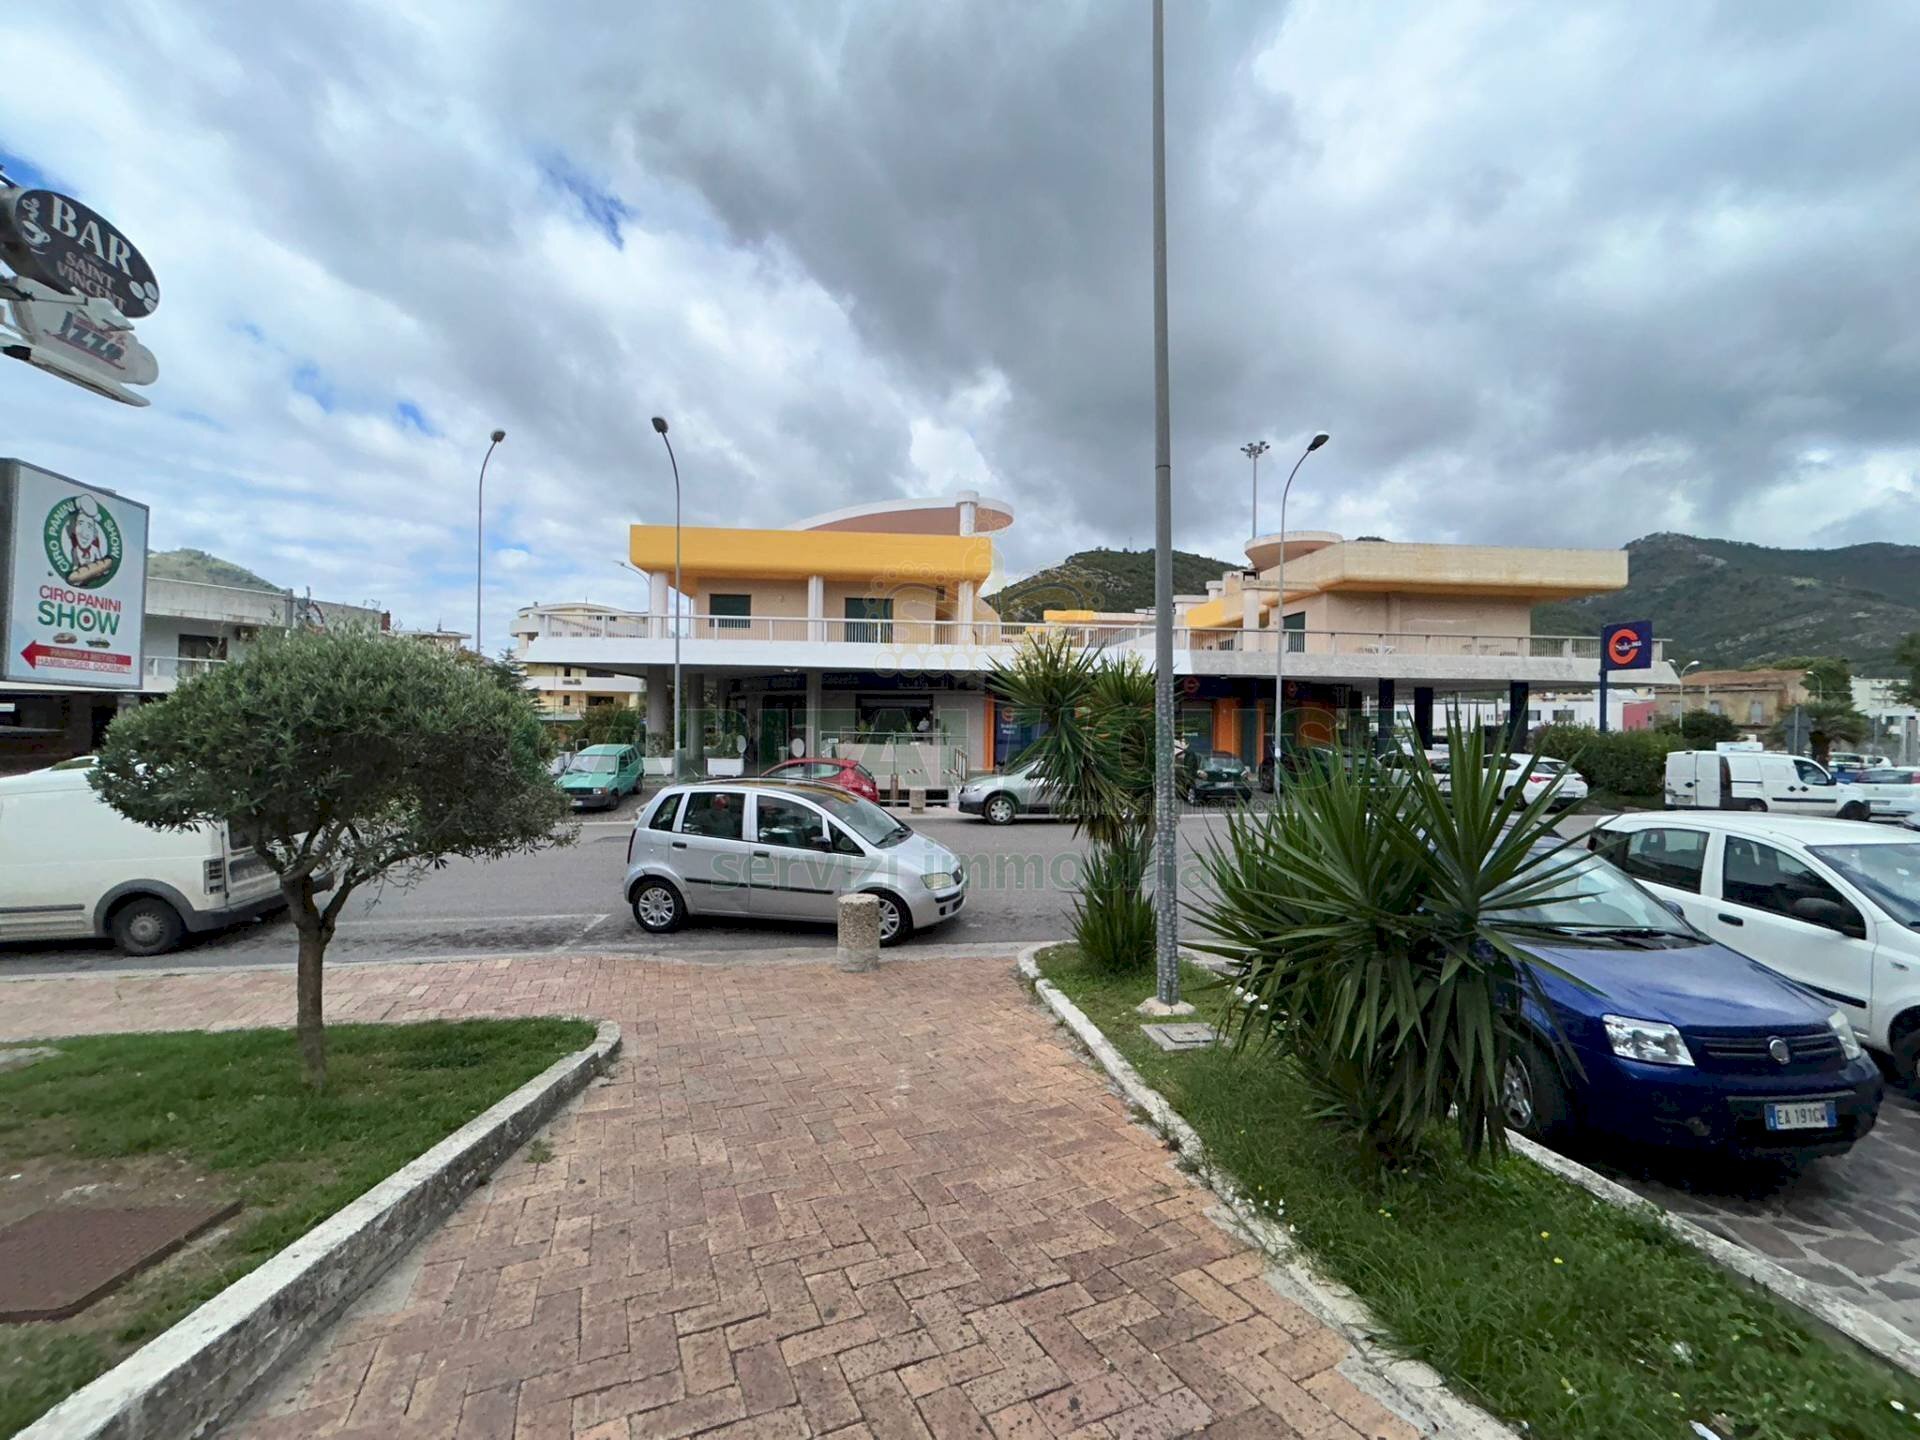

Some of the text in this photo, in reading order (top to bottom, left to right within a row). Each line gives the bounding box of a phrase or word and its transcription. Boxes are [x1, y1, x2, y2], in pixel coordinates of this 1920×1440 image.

[51, 194, 133, 277] BAR
[57, 260, 126, 312] VINCENT
[65, 251, 115, 290] SAINT
[49, 540, 70, 572] CIRO
[104, 519, 120, 559] SHOW
[38, 600, 120, 635] SHOW
[40, 585, 121, 612] CIRO PANINI
